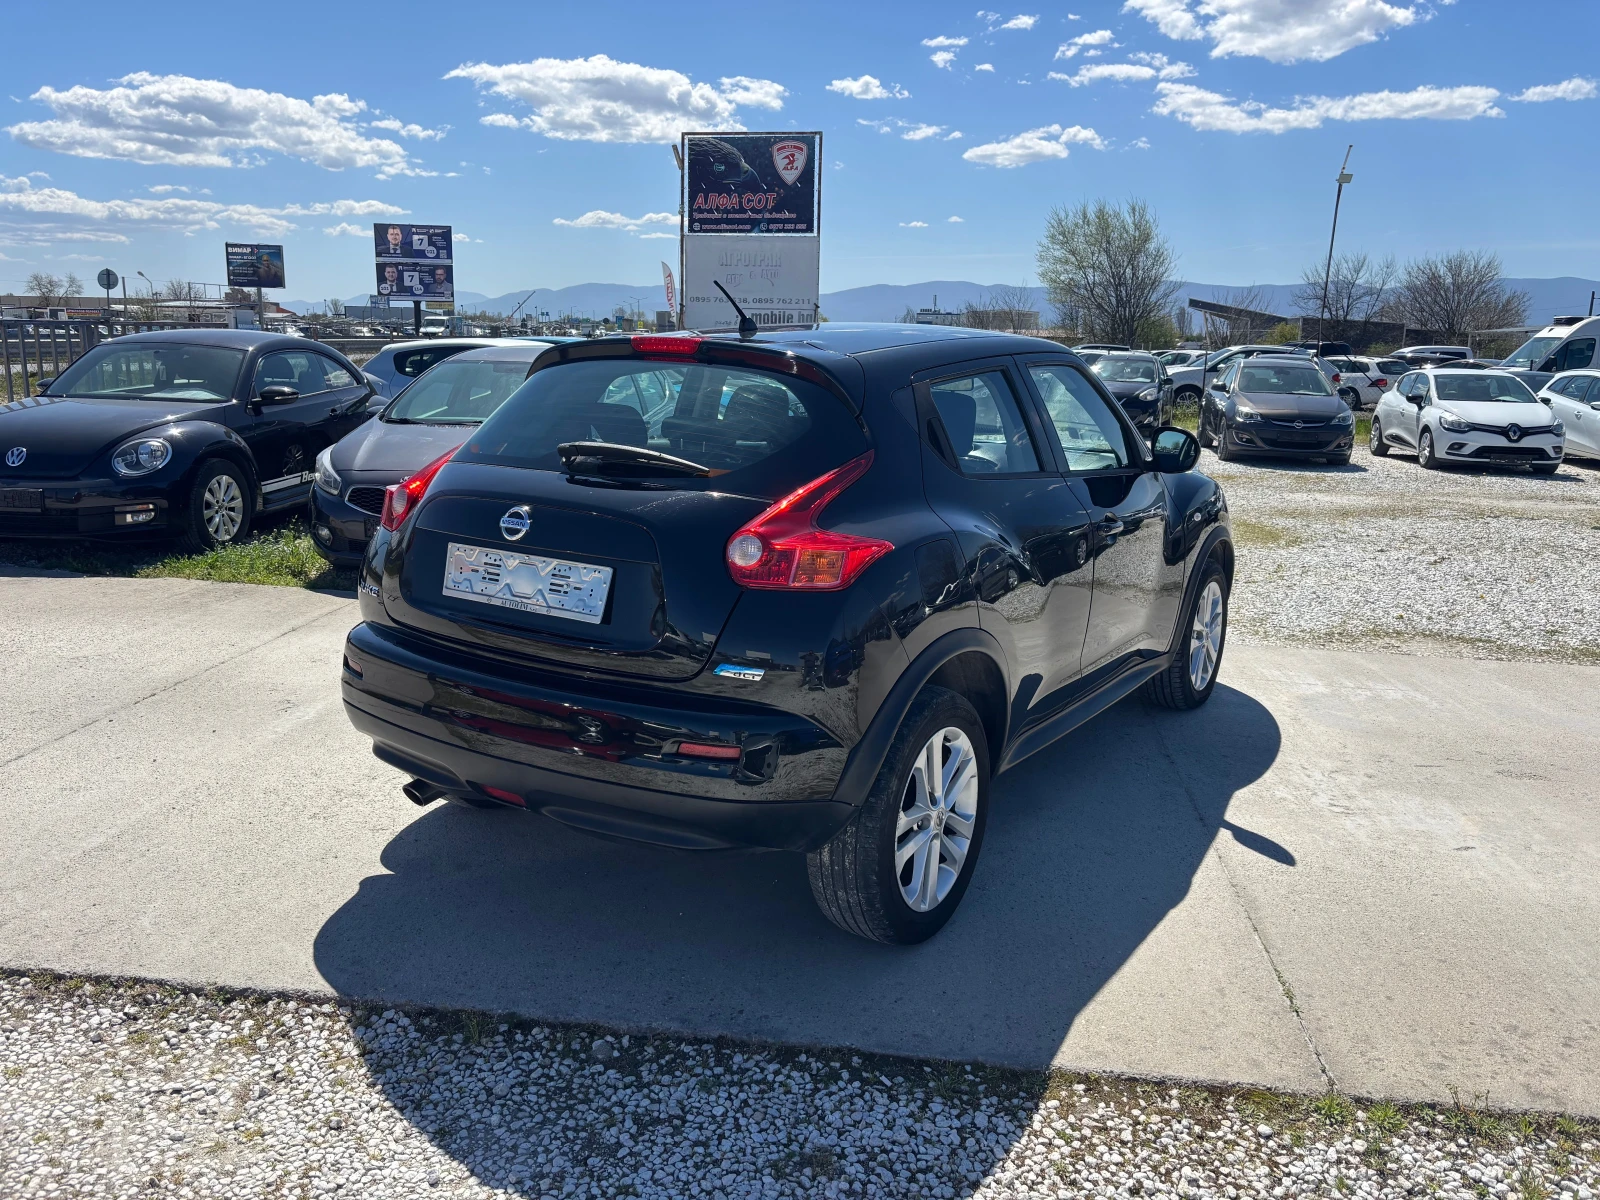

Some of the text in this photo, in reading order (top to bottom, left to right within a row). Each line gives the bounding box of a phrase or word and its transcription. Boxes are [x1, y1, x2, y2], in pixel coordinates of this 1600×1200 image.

[693, 193, 776, 209] АЛФА СОТ
[502, 519, 526, 527] NISSAN
